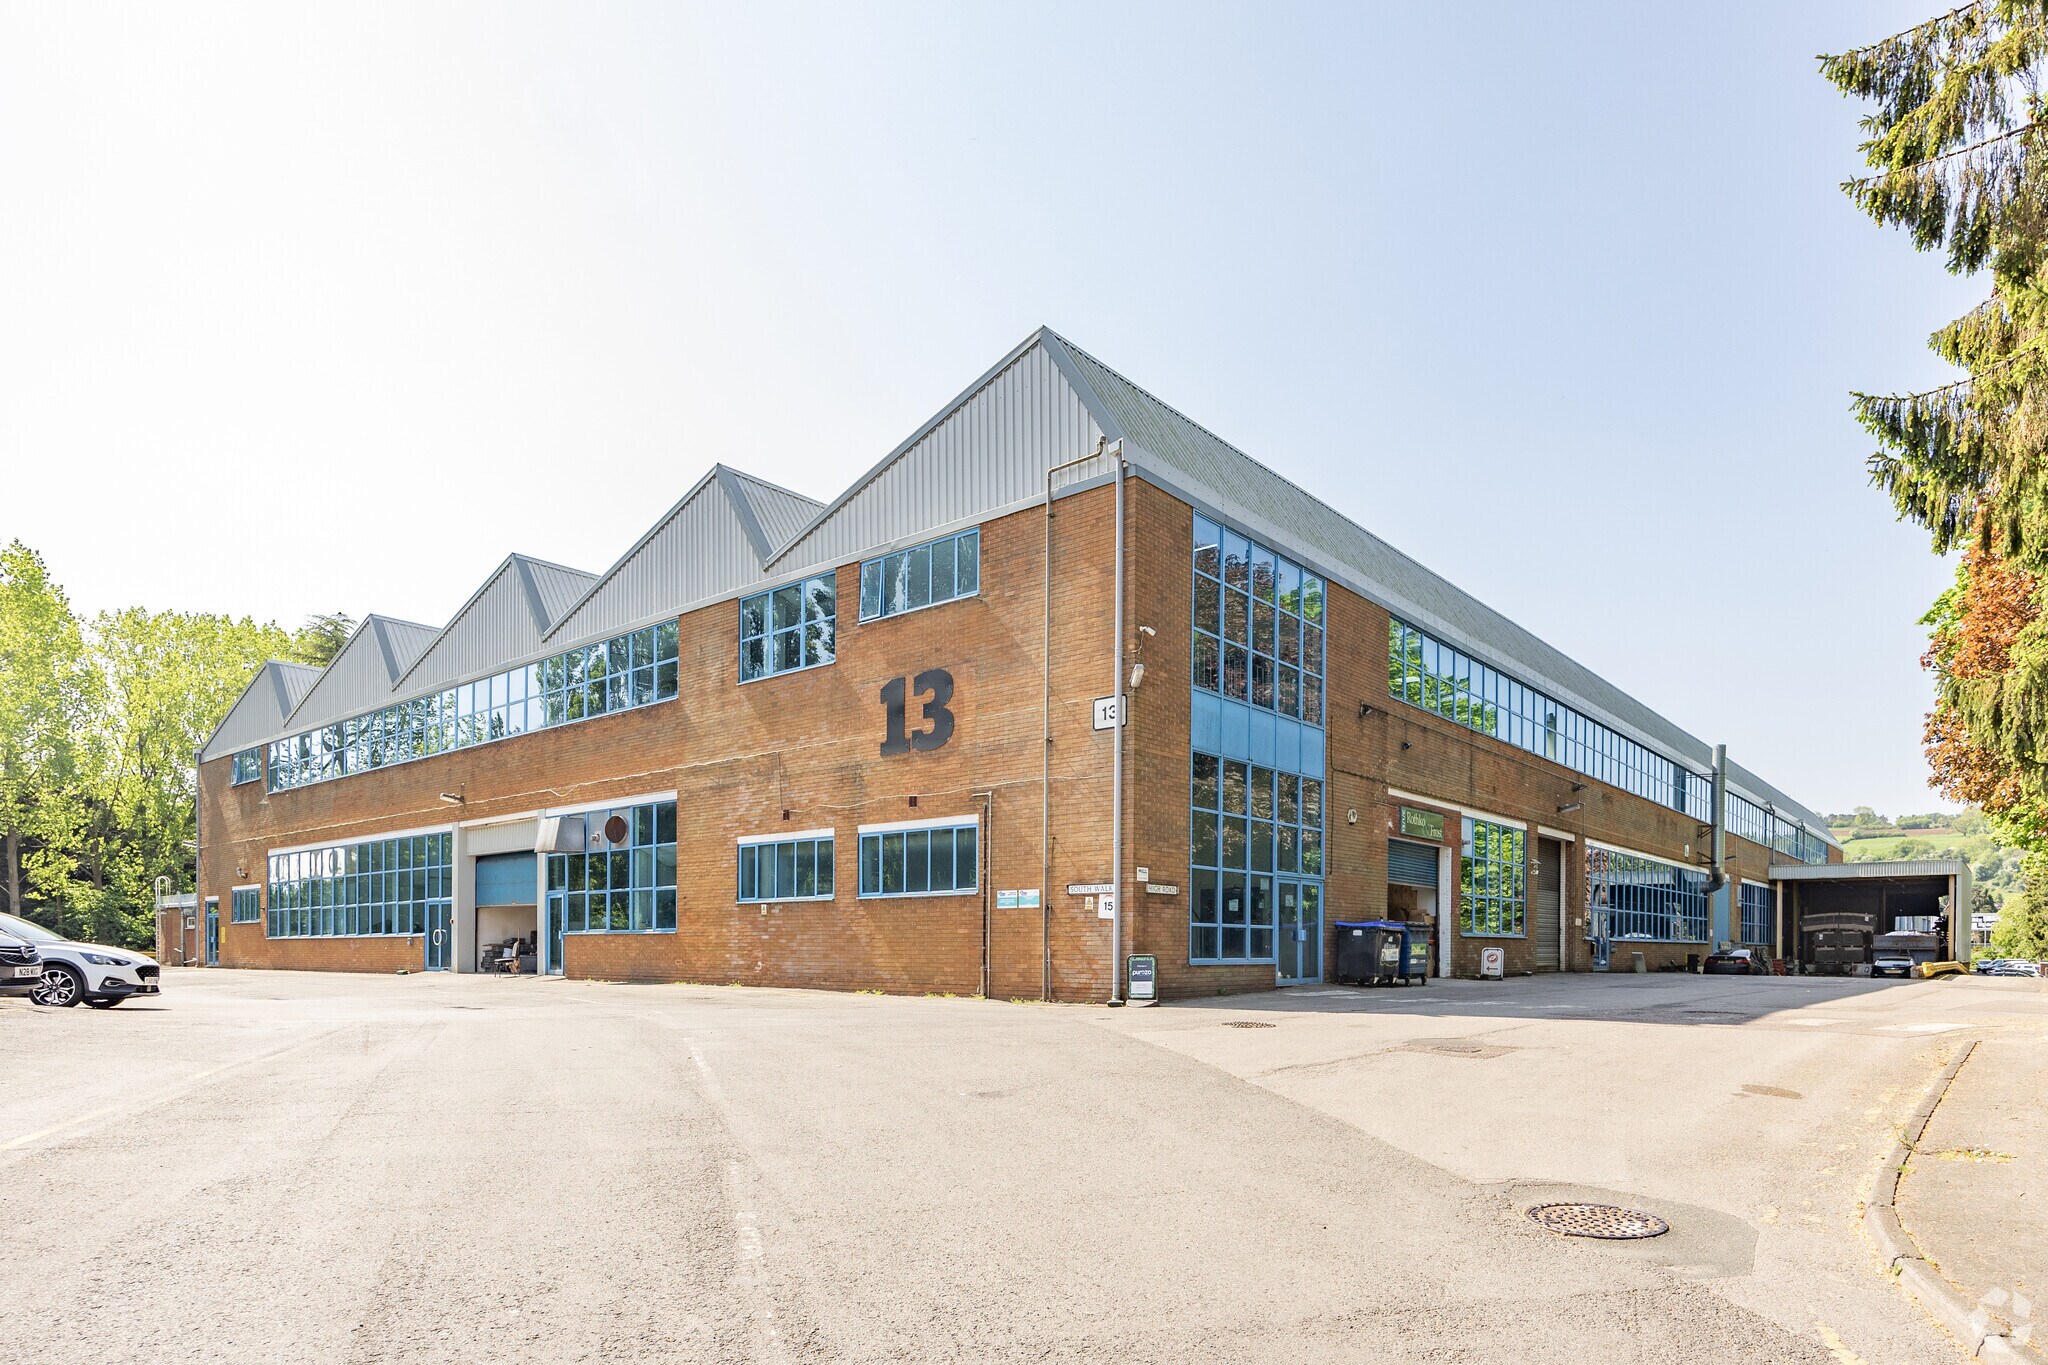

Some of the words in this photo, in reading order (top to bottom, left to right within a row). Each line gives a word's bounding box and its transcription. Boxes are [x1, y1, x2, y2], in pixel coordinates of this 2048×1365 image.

[880, 668, 955, 756] 13
[1102, 704, 1115, 720] 13
[1406, 811, 1427, 827] Rothko
[1104, 901, 1113, 911] 15
